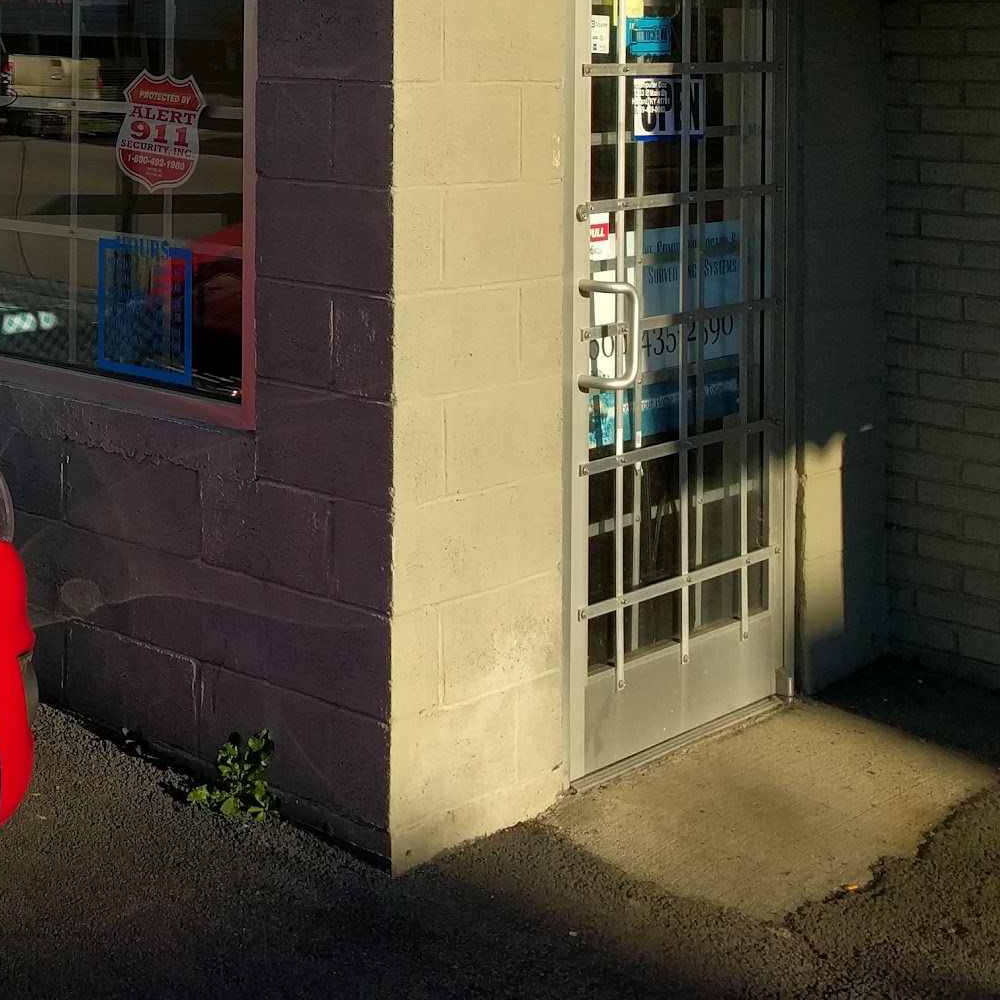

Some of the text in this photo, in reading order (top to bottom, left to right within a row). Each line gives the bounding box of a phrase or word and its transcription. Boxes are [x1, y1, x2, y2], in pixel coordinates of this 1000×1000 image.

[138, 90, 192, 105] PROTECTED BY
[129, 105, 196, 126] ALERT
[130, 120, 189, 148] 911
